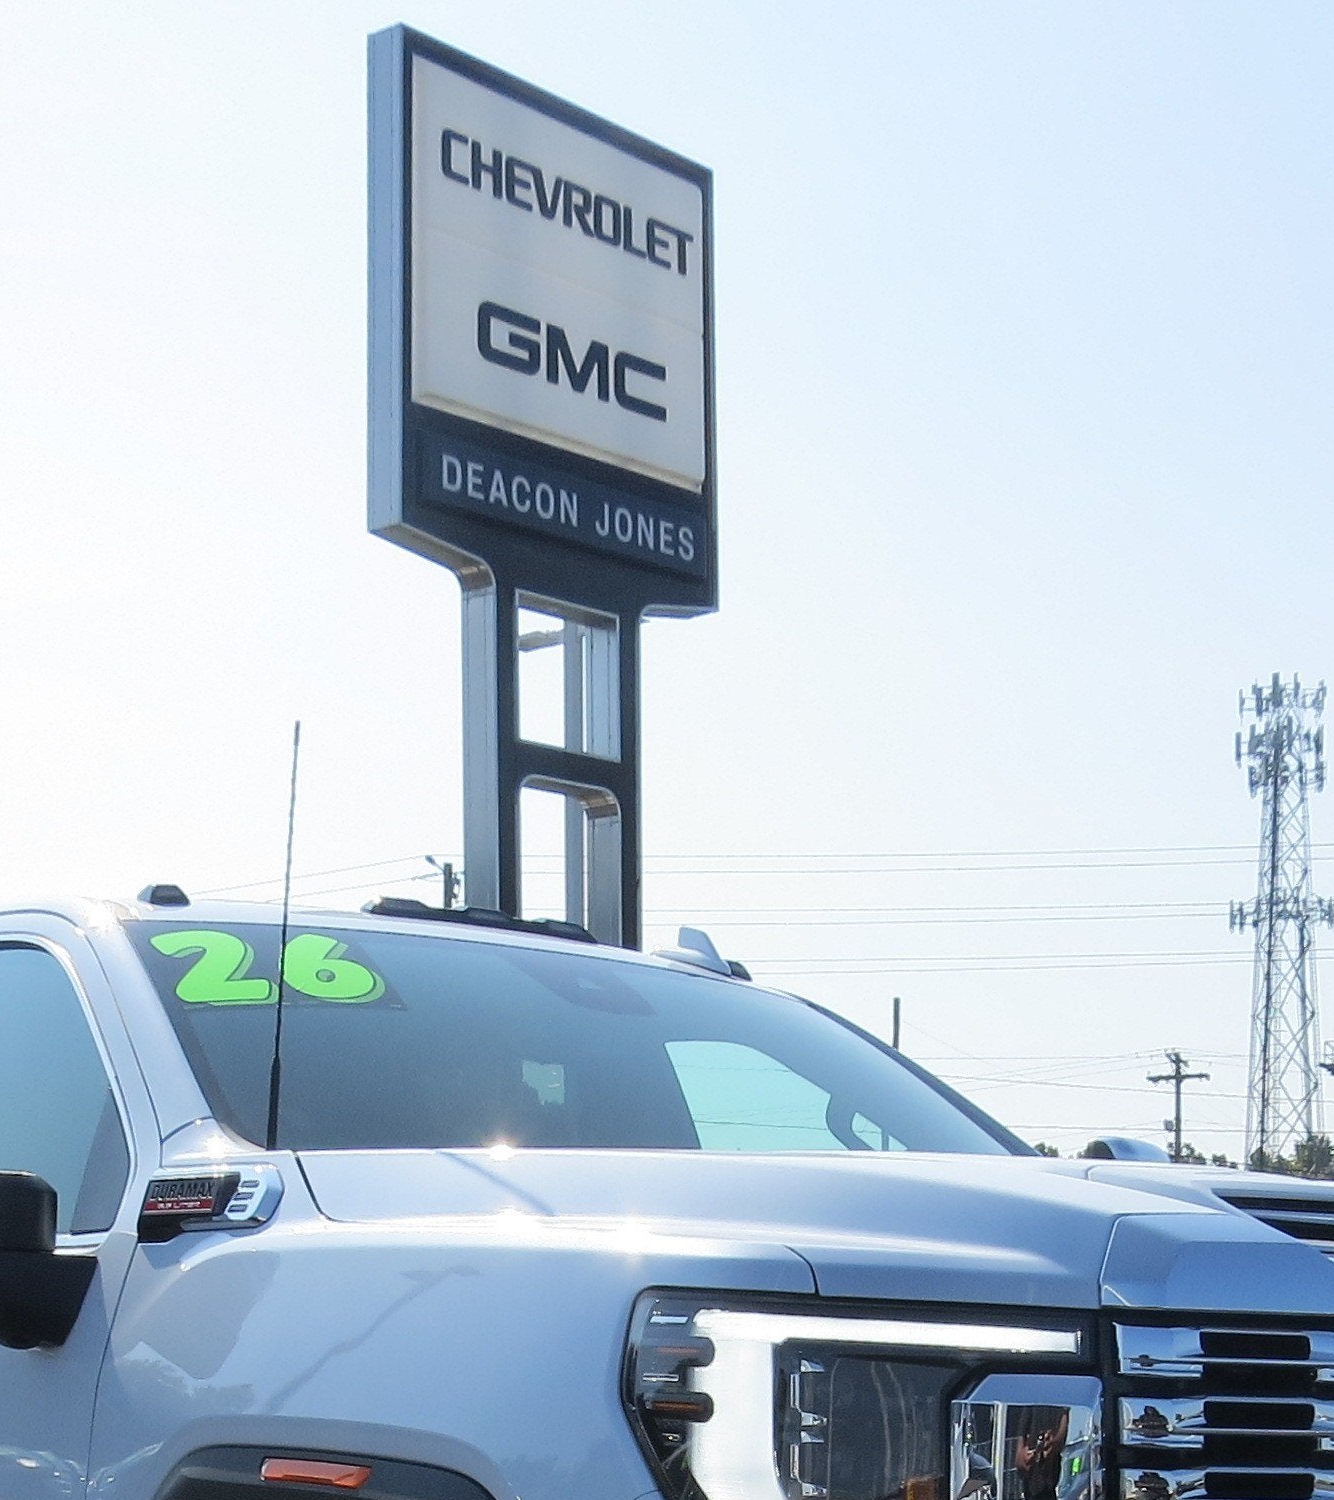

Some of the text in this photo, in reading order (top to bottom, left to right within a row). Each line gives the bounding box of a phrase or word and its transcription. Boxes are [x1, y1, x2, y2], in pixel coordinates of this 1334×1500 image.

[440, 127, 693, 276] CHEVROLET
[477, 300, 667, 422] GMC
[441, 454, 695, 561] DEACON JONES
[150, 930, 386, 1005] 26
[150, 1180, 216, 1199] DURAMAX
